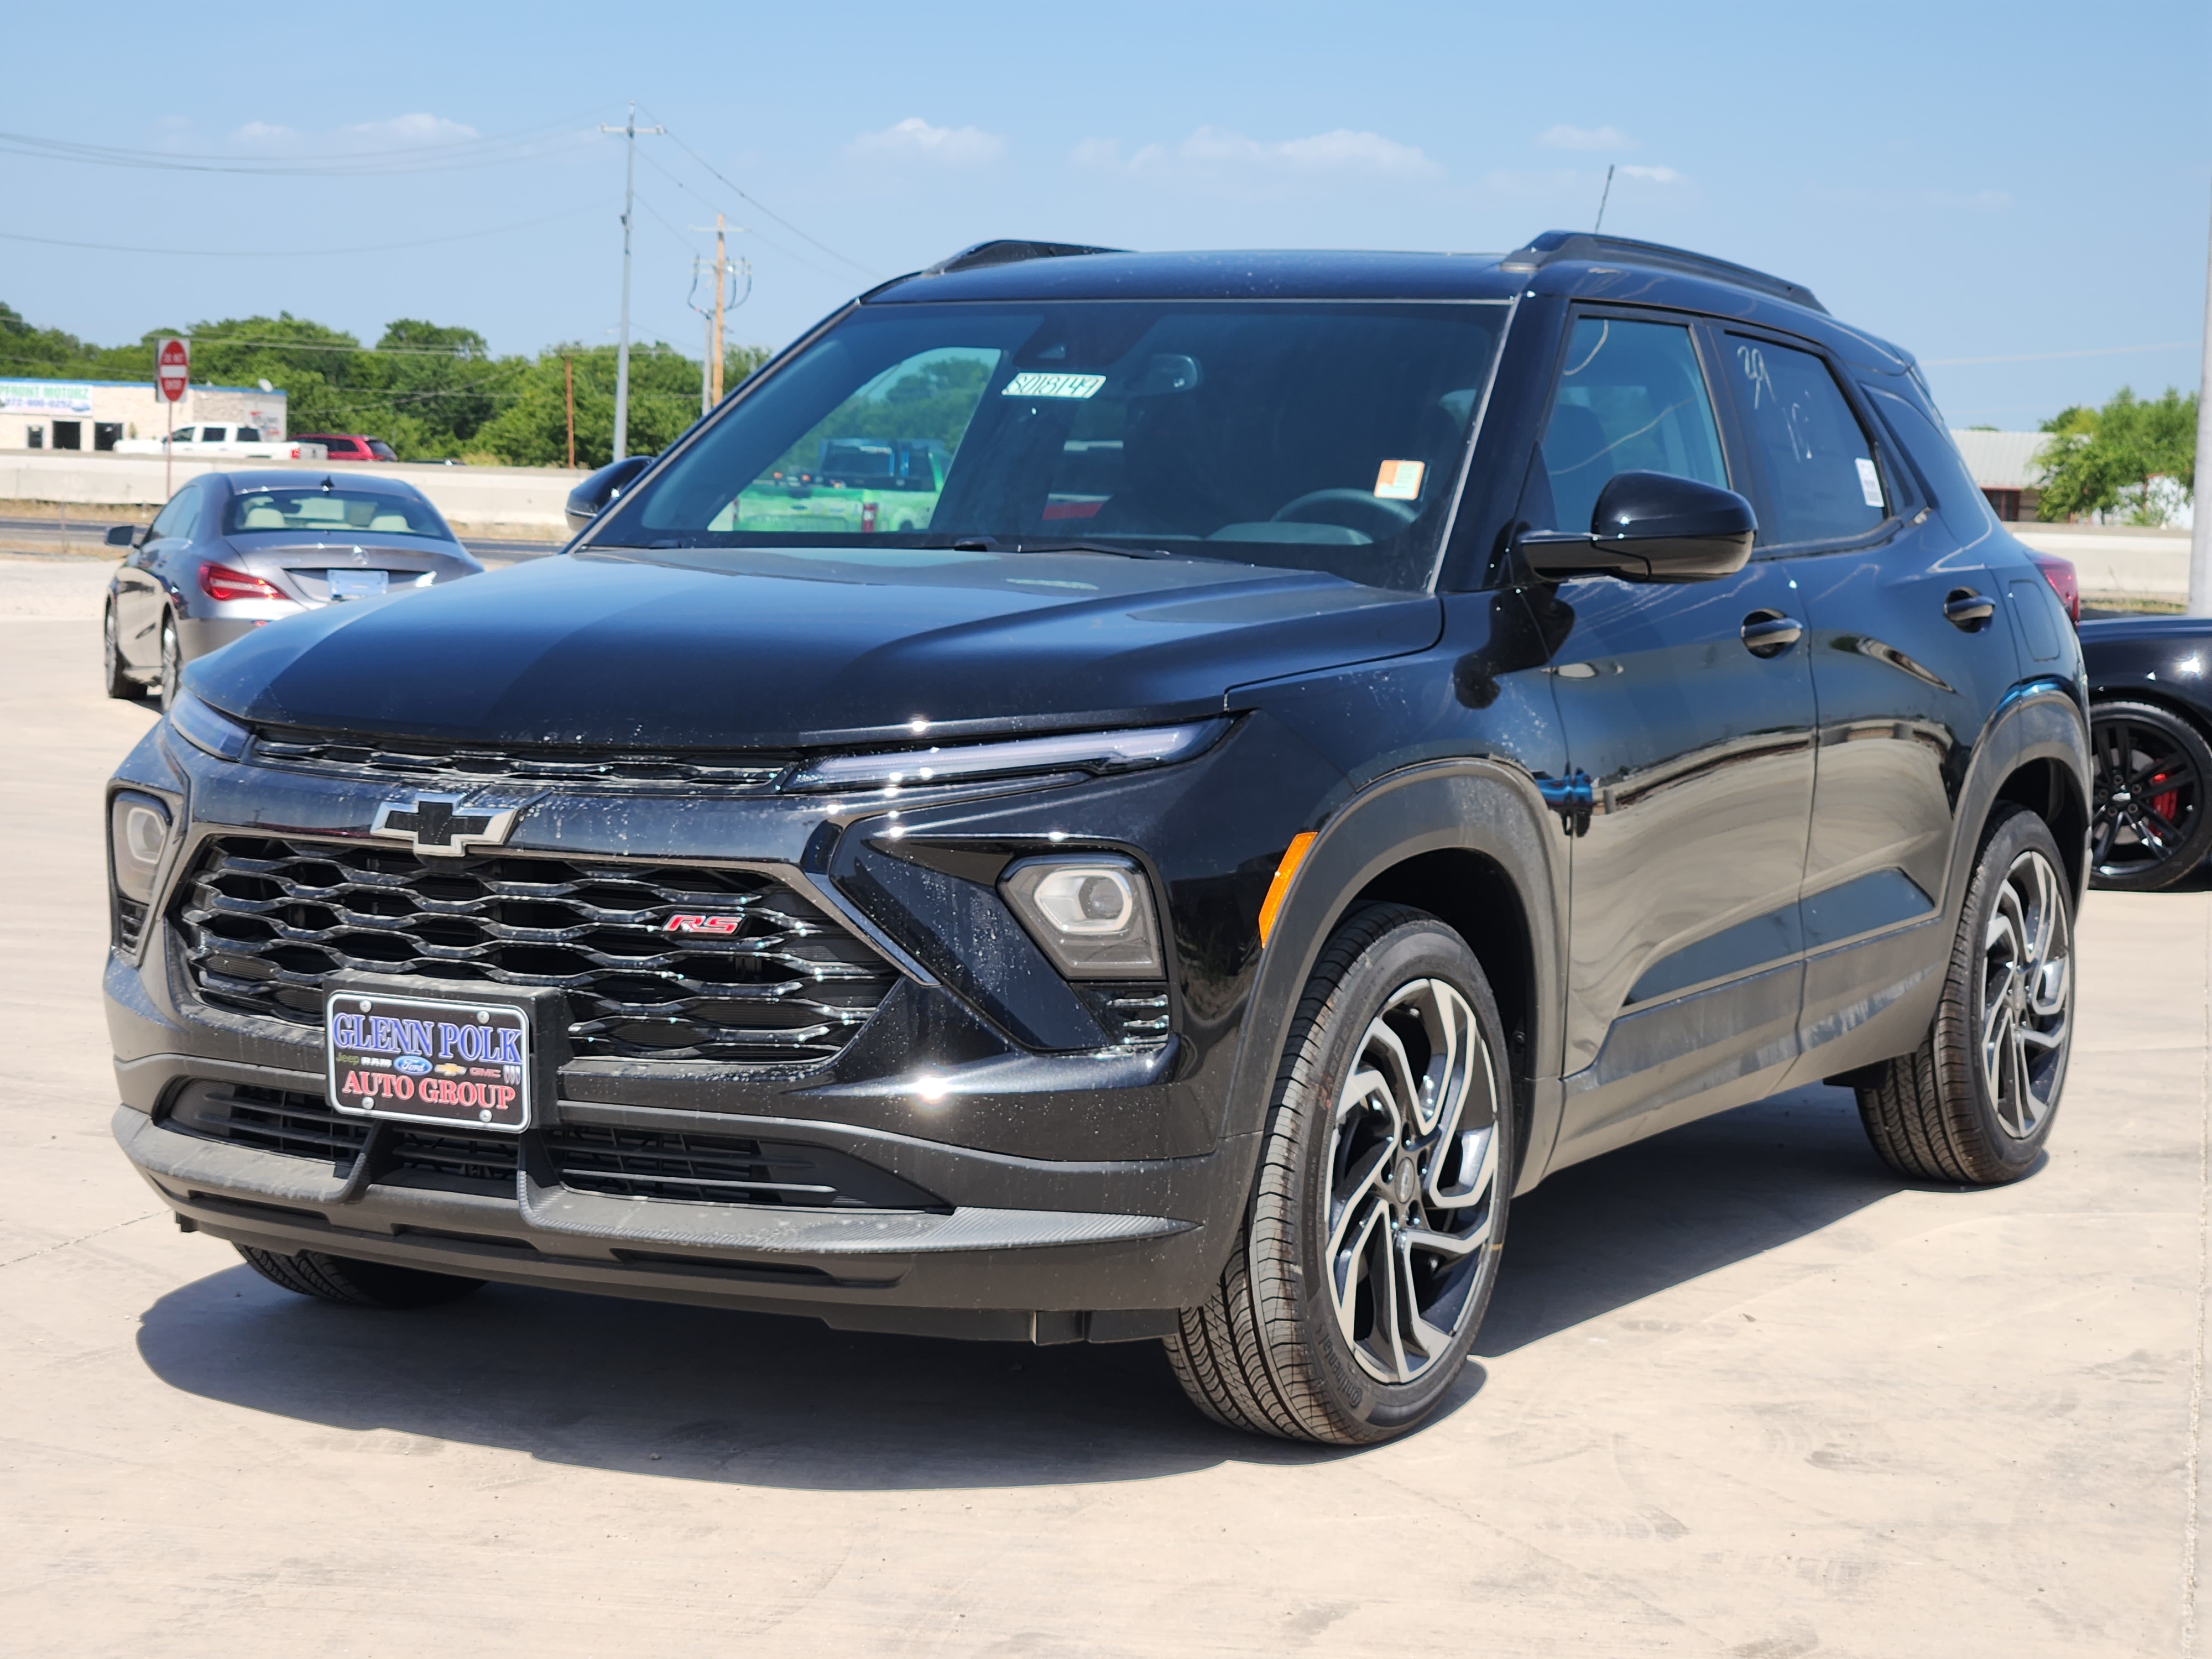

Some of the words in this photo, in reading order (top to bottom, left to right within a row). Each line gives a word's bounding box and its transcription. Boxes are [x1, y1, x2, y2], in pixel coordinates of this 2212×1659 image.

[662, 914, 743, 935] RS
[333, 1012, 435, 1057] GLENN
[438, 1022, 523, 1065] POLK
[336, 1052, 360, 1064] Jeep
[361, 1053, 393, 1066] RAM
[401, 1058, 426, 1072] Ford
[469, 1066, 502, 1078] GMC
[342, 1070, 415, 1100] AUTO
[419, 1077, 516, 1110] GROUP
[1318, 1333, 1363, 1409] Continental
